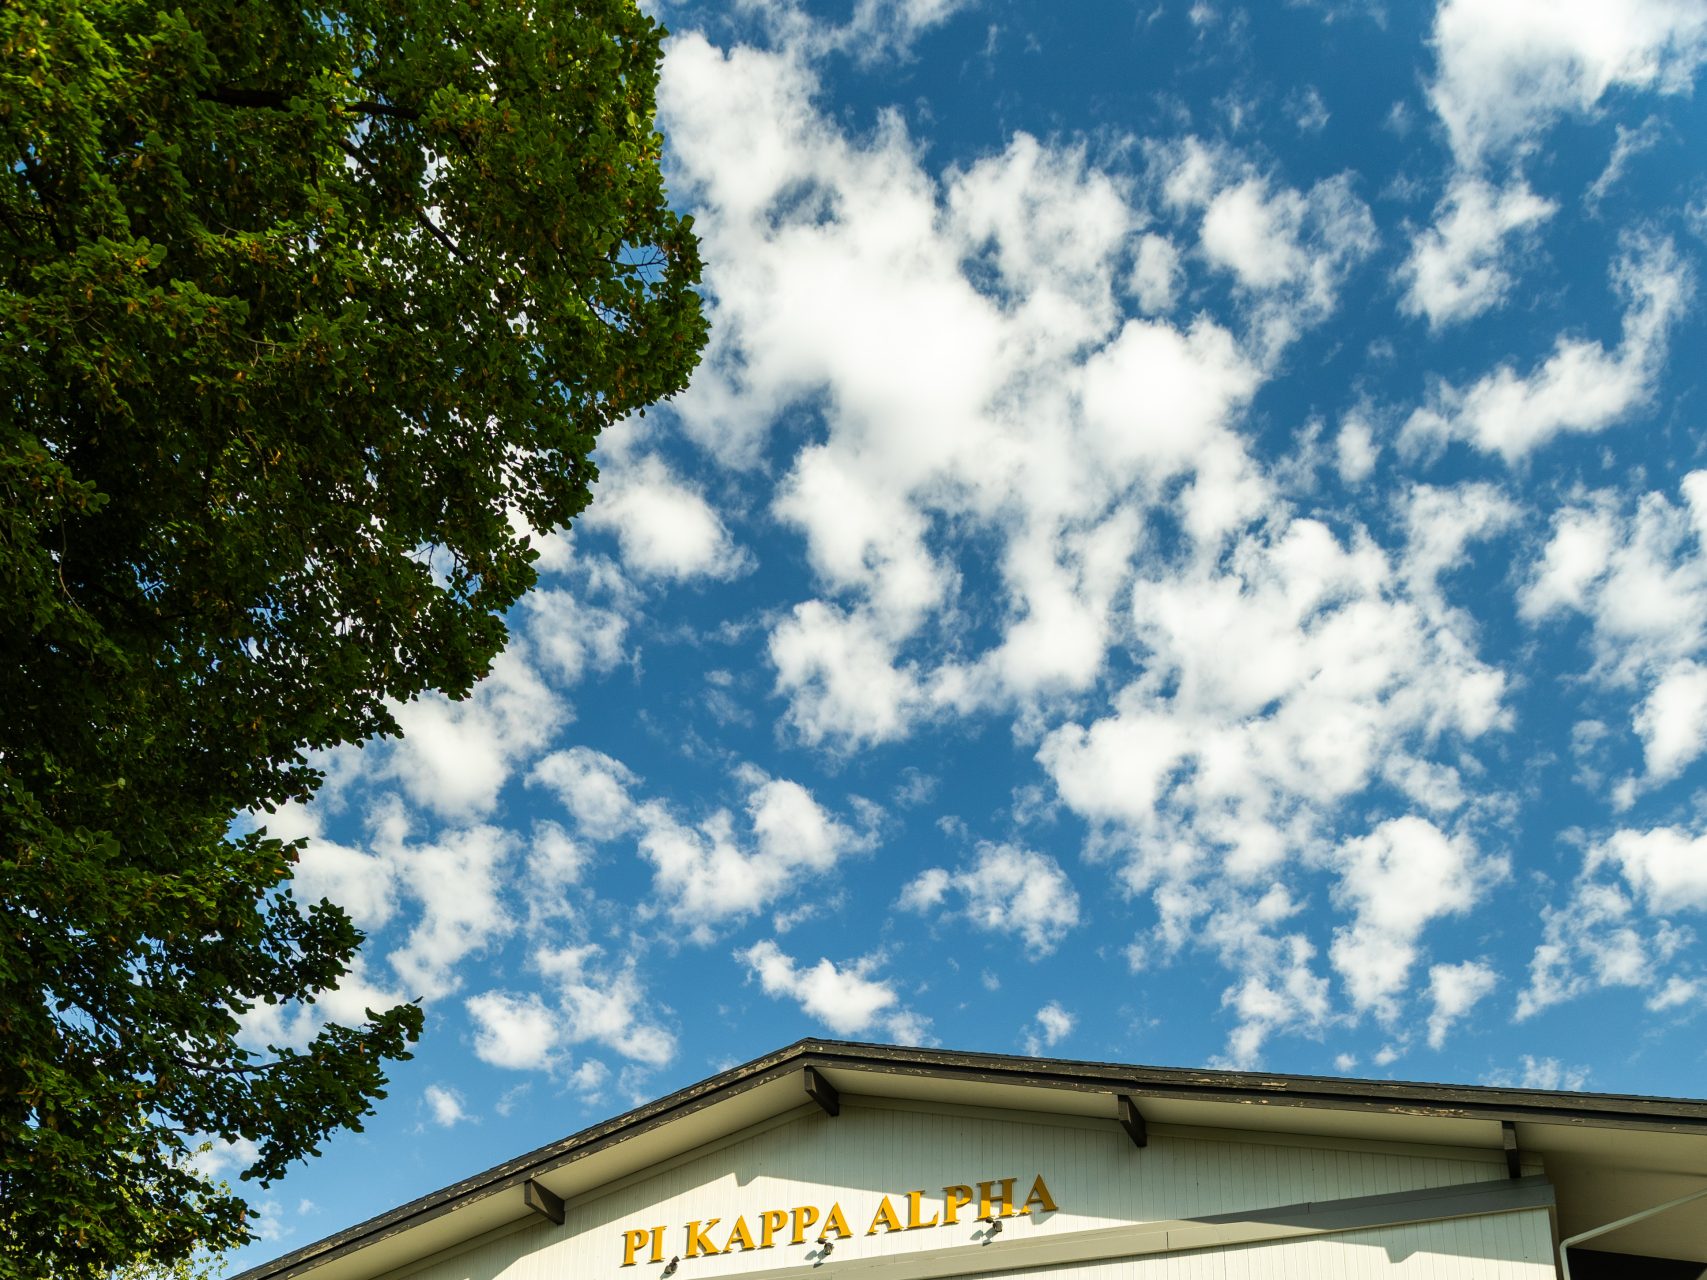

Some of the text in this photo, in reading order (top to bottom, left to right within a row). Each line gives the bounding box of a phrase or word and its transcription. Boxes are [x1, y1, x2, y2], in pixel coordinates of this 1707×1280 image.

[621, 1174, 1059, 1267] PI KAPPA ALPHA
